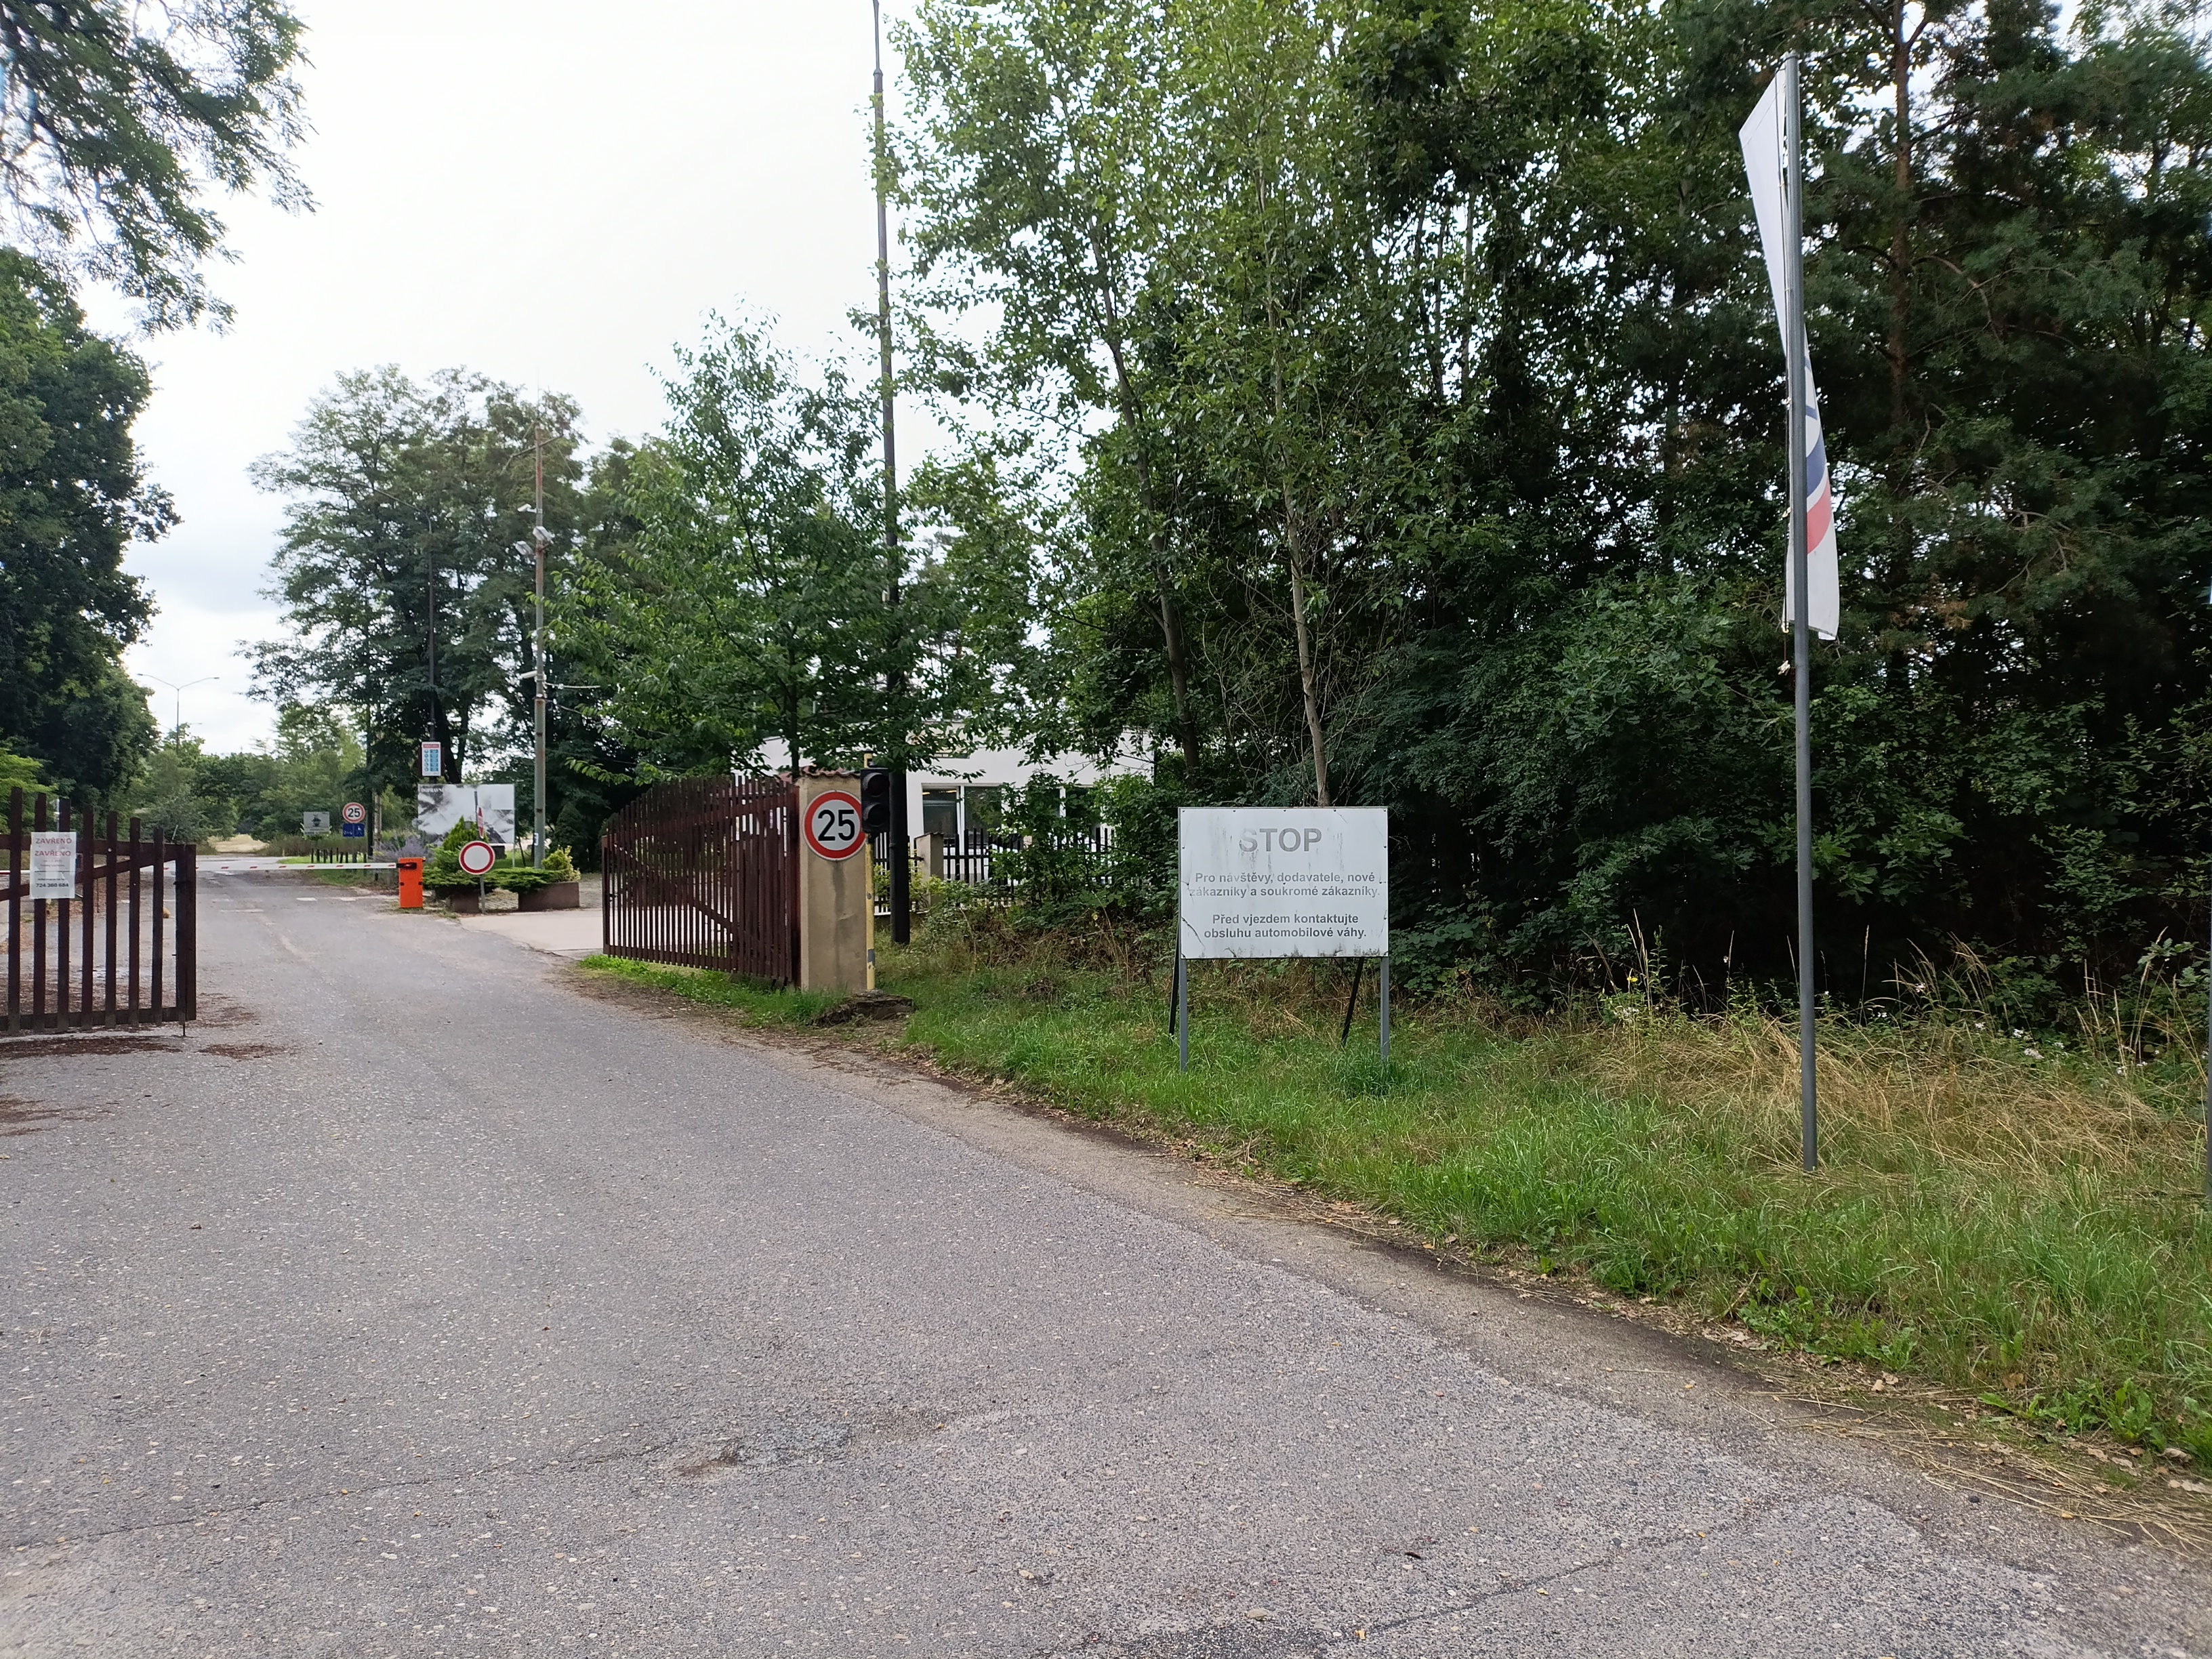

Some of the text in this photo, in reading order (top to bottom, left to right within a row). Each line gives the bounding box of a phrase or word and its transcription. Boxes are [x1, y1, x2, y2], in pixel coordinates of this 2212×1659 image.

[348, 807, 361, 818] 25
[817, 809, 855, 841] 25
[1239, 827, 1322, 852] STOP
[1195, 872, 1375, 884] Pro návštěvy, dodavatele, nové
[1190, 886, 1380, 898] zákazníky a soukromé zákazníky.
[1212, 914, 1359, 926] Před vjezdem kontaktujte
[1204, 927, 1367, 939] obsluhu automobilové váhy.
